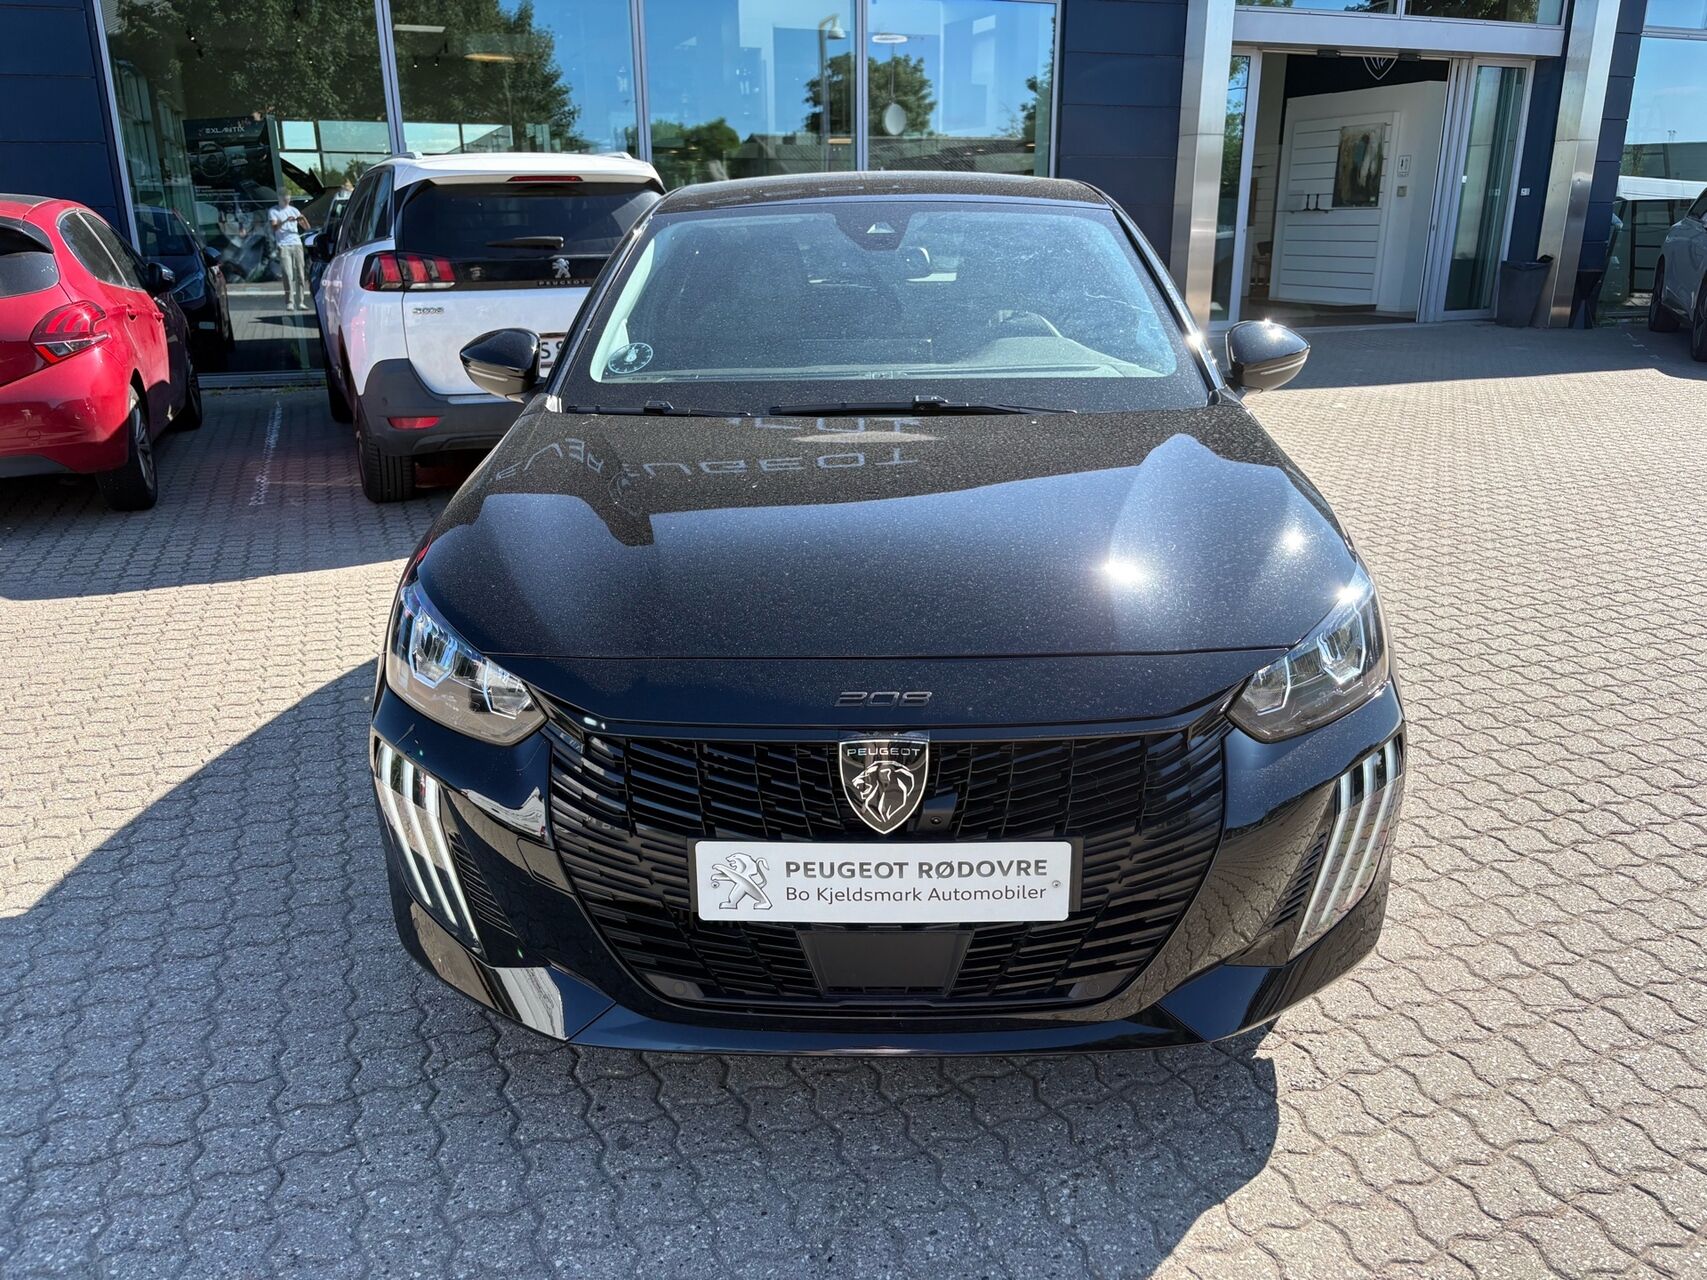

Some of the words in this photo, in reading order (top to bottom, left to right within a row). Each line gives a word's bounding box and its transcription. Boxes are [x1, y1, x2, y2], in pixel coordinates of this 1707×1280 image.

[834, 691, 933, 707] 208
[847, 747, 920, 757] PEUGEOT
[785, 861, 909, 880] PEUGEOT
[918, 859, 1048, 880] RØDOVRE
[786, 887, 810, 901] Bo
[817, 886, 923, 905] Kjeldsmark
[928, 885, 1047, 901] Automobiler
